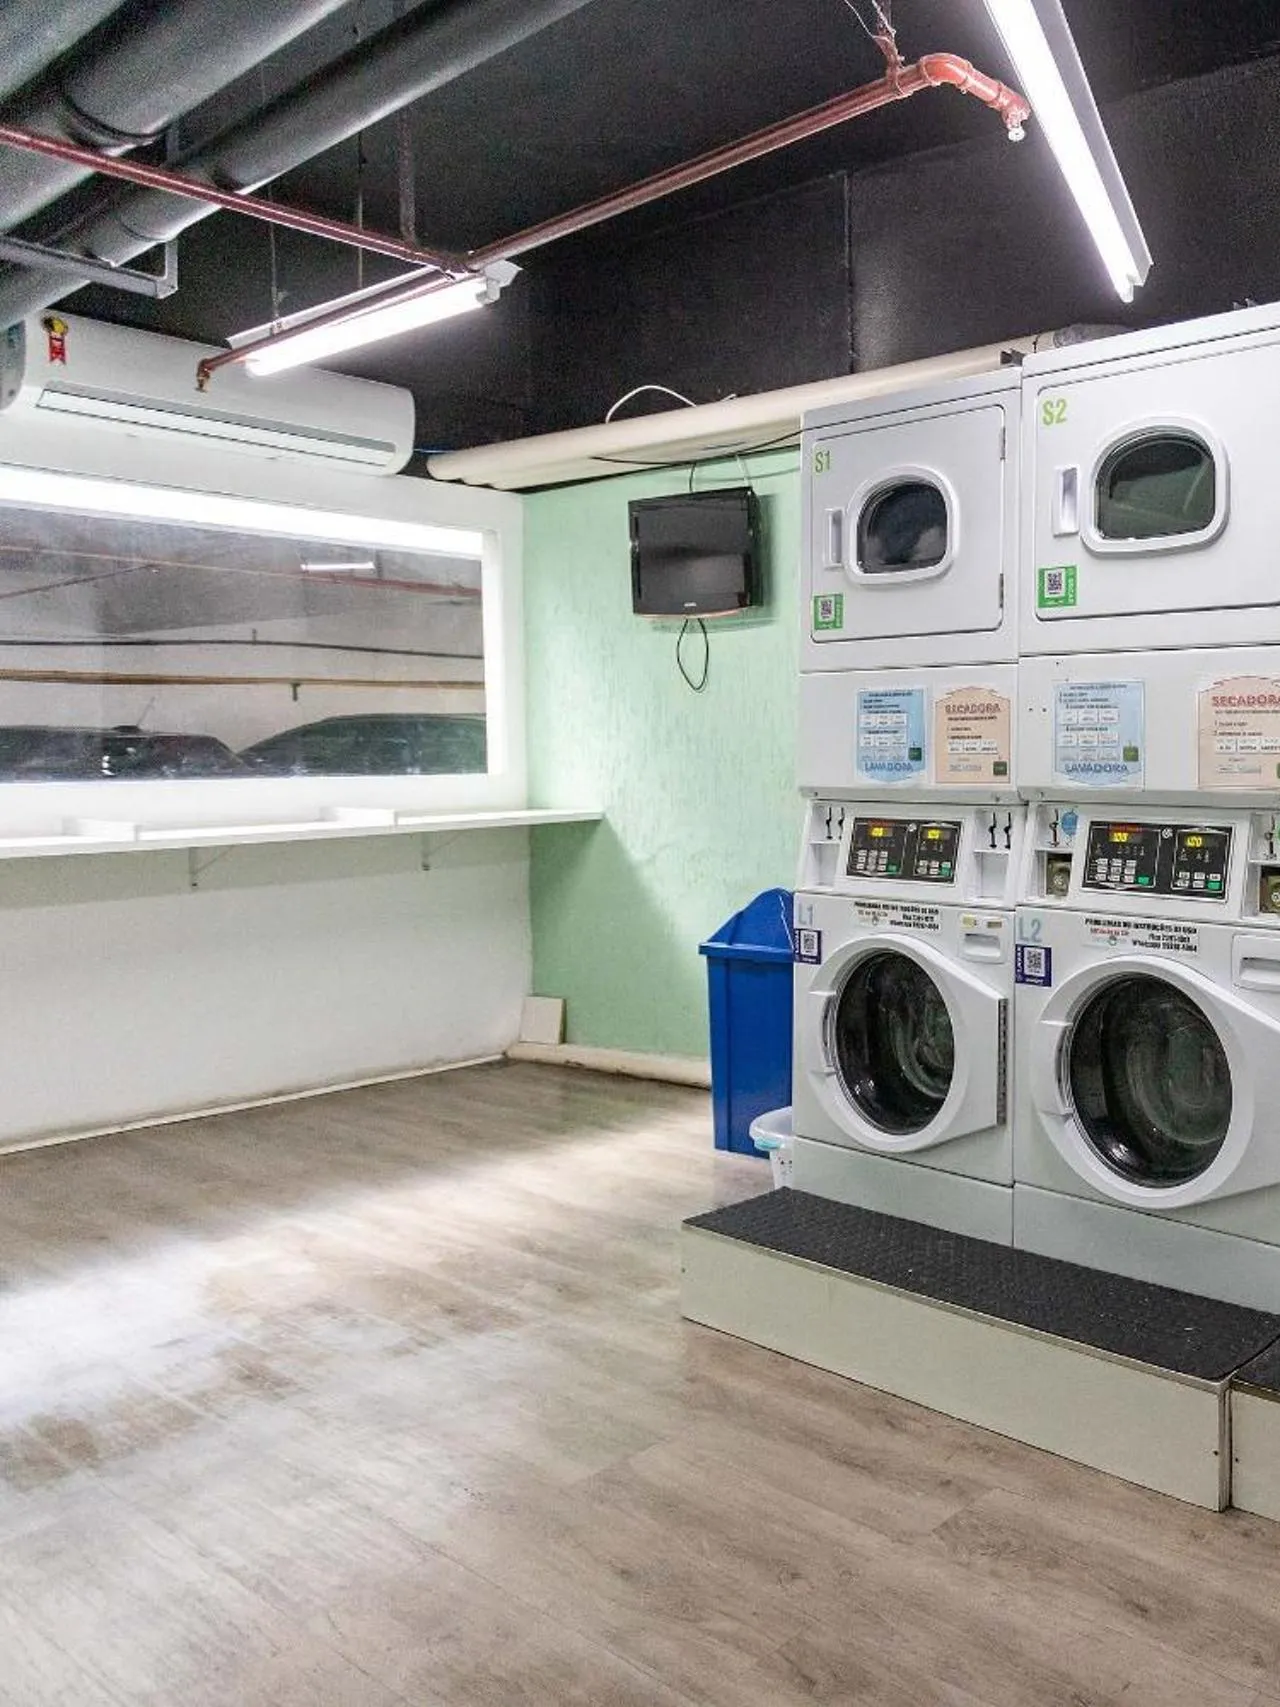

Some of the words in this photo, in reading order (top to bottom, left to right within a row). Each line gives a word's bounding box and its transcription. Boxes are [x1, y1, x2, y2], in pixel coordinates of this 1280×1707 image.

[1042, 399, 1067, 425] S2
[815, 450, 830, 473] S1
[1065, 762, 1129, 773] LAVADORA
[1019, 917, 1043, 943] L2
